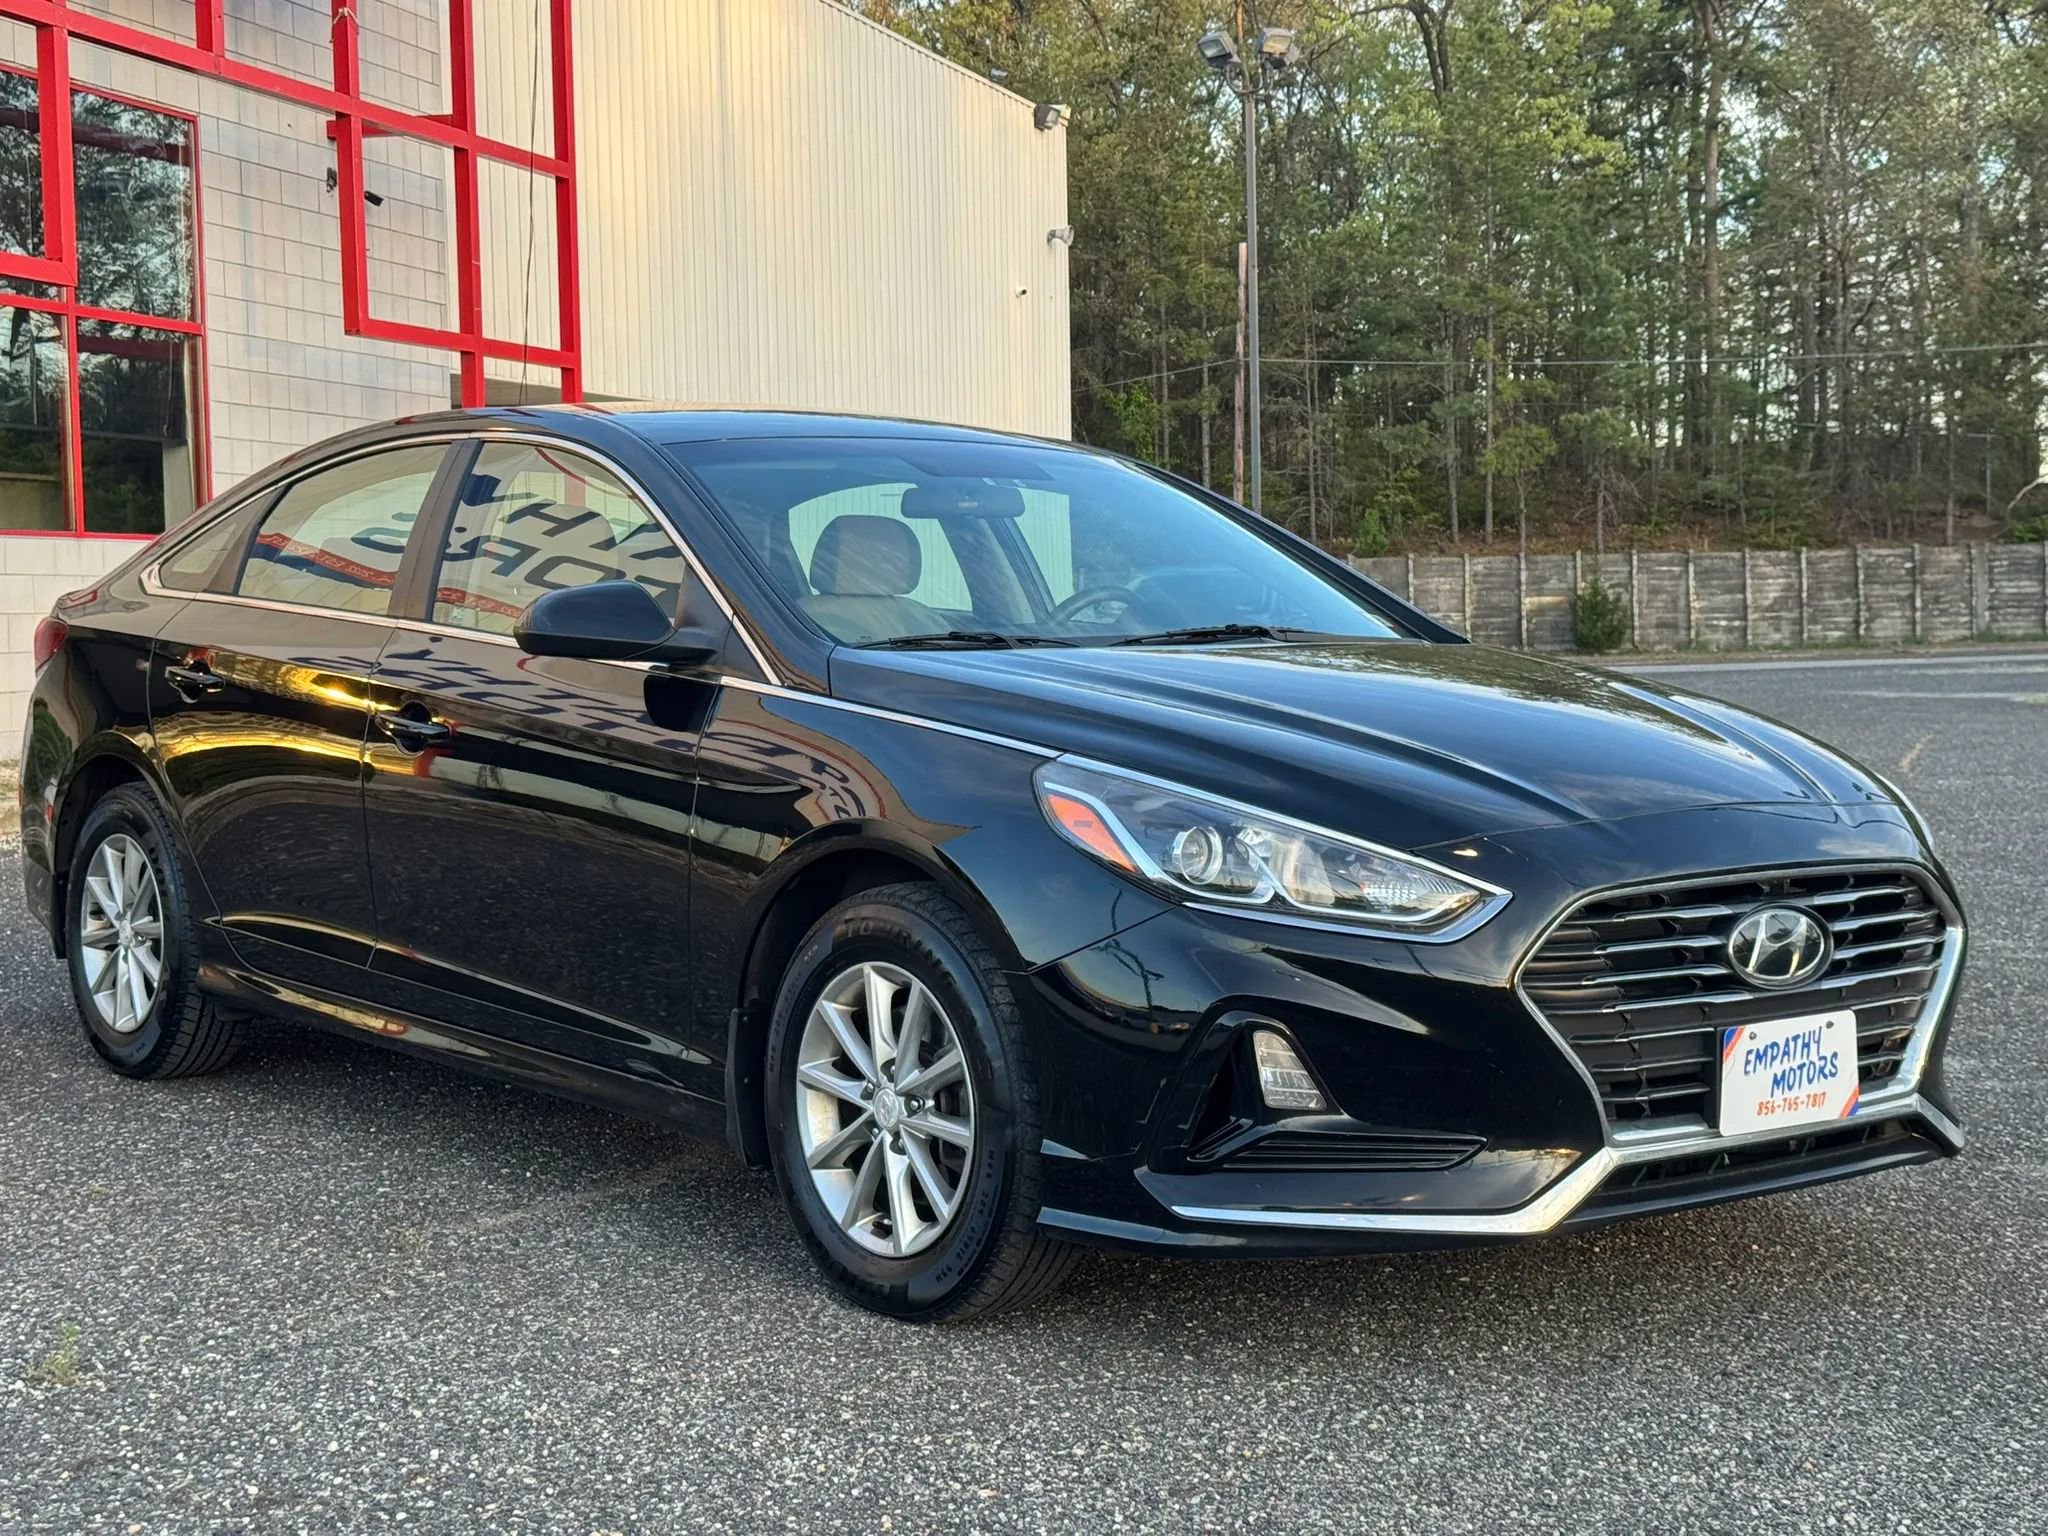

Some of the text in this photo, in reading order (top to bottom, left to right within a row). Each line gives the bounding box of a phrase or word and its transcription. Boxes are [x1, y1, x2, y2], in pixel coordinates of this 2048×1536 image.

[1744, 1026, 1823, 1076] EMPATHY
[1770, 1052, 1839, 1099] MOTORS
[1756, 1091, 1827, 1116] 856-765-7817
